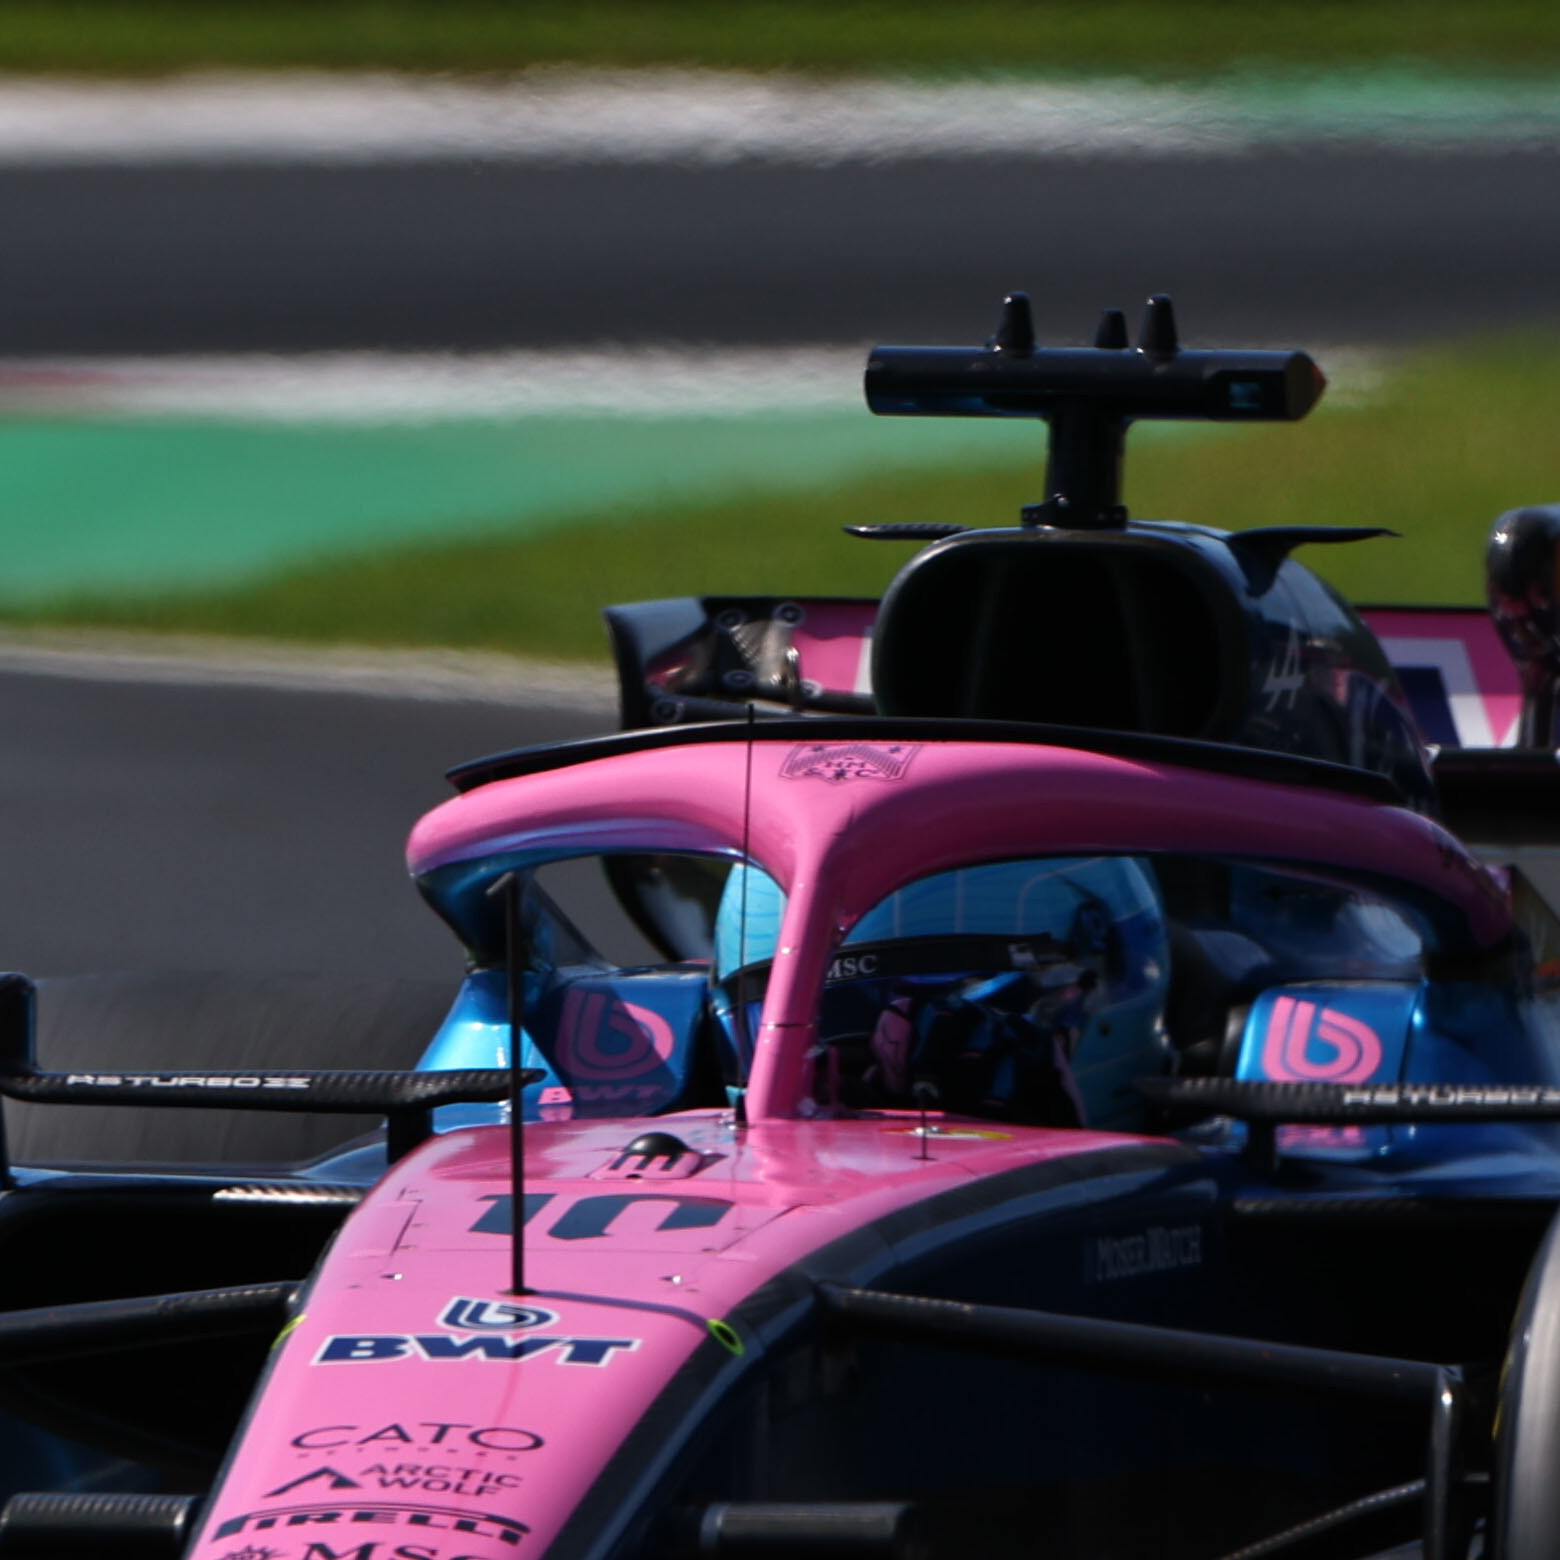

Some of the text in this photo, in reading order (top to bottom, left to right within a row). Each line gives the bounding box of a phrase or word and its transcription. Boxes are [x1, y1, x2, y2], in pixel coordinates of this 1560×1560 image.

[468, 1193, 736, 1240] 10
[310, 1334, 642, 1368] BWT
[291, 1423, 544, 1450] CATO
[359, 1463, 523, 1488] ARCTIC
[378, 1477, 502, 1496] WOLF
[212, 1501, 532, 1546] PIRELLI
